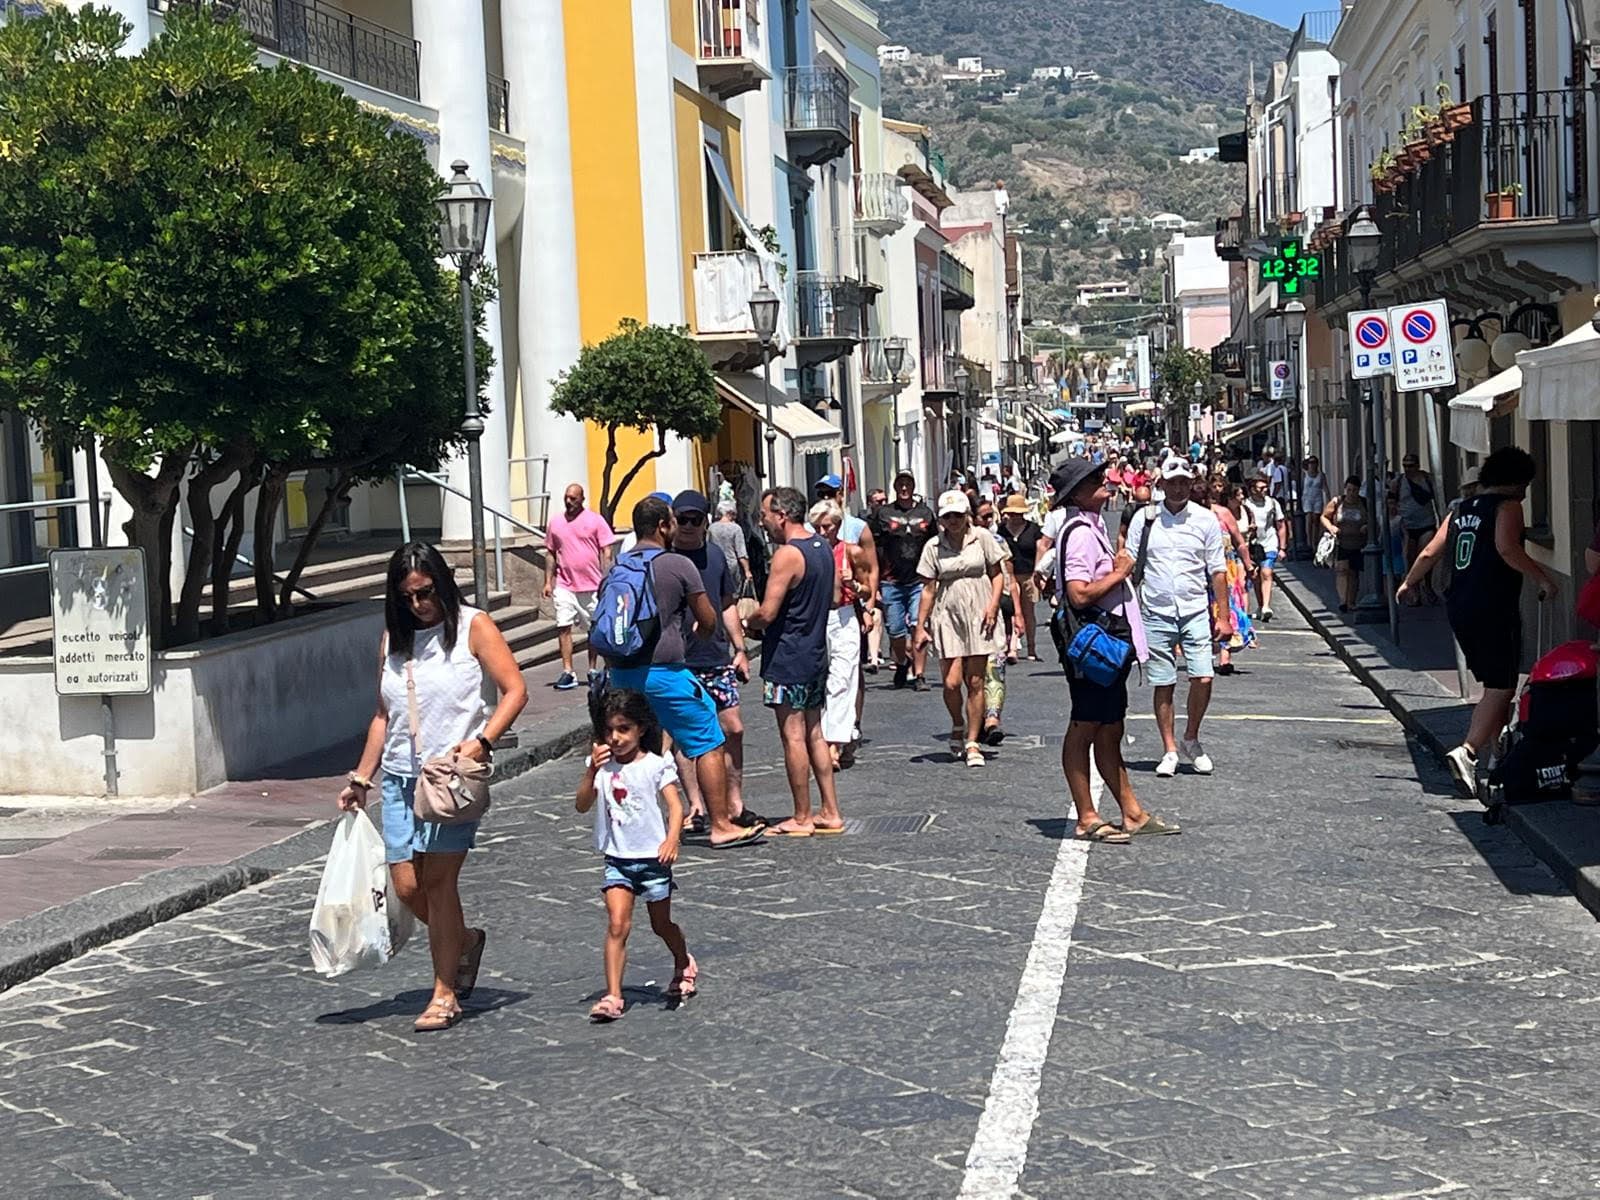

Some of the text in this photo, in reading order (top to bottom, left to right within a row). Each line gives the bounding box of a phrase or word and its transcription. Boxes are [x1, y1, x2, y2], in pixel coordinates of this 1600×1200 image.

[1263, 257, 1319, 278] 12:32
[1455, 514, 1481, 530] TATUM
[1456, 531, 1476, 570] 0
[62, 632, 101, 643] eccetto
[60, 652, 145, 664] addetti mercato
[87, 671, 138, 683] autorizzati
